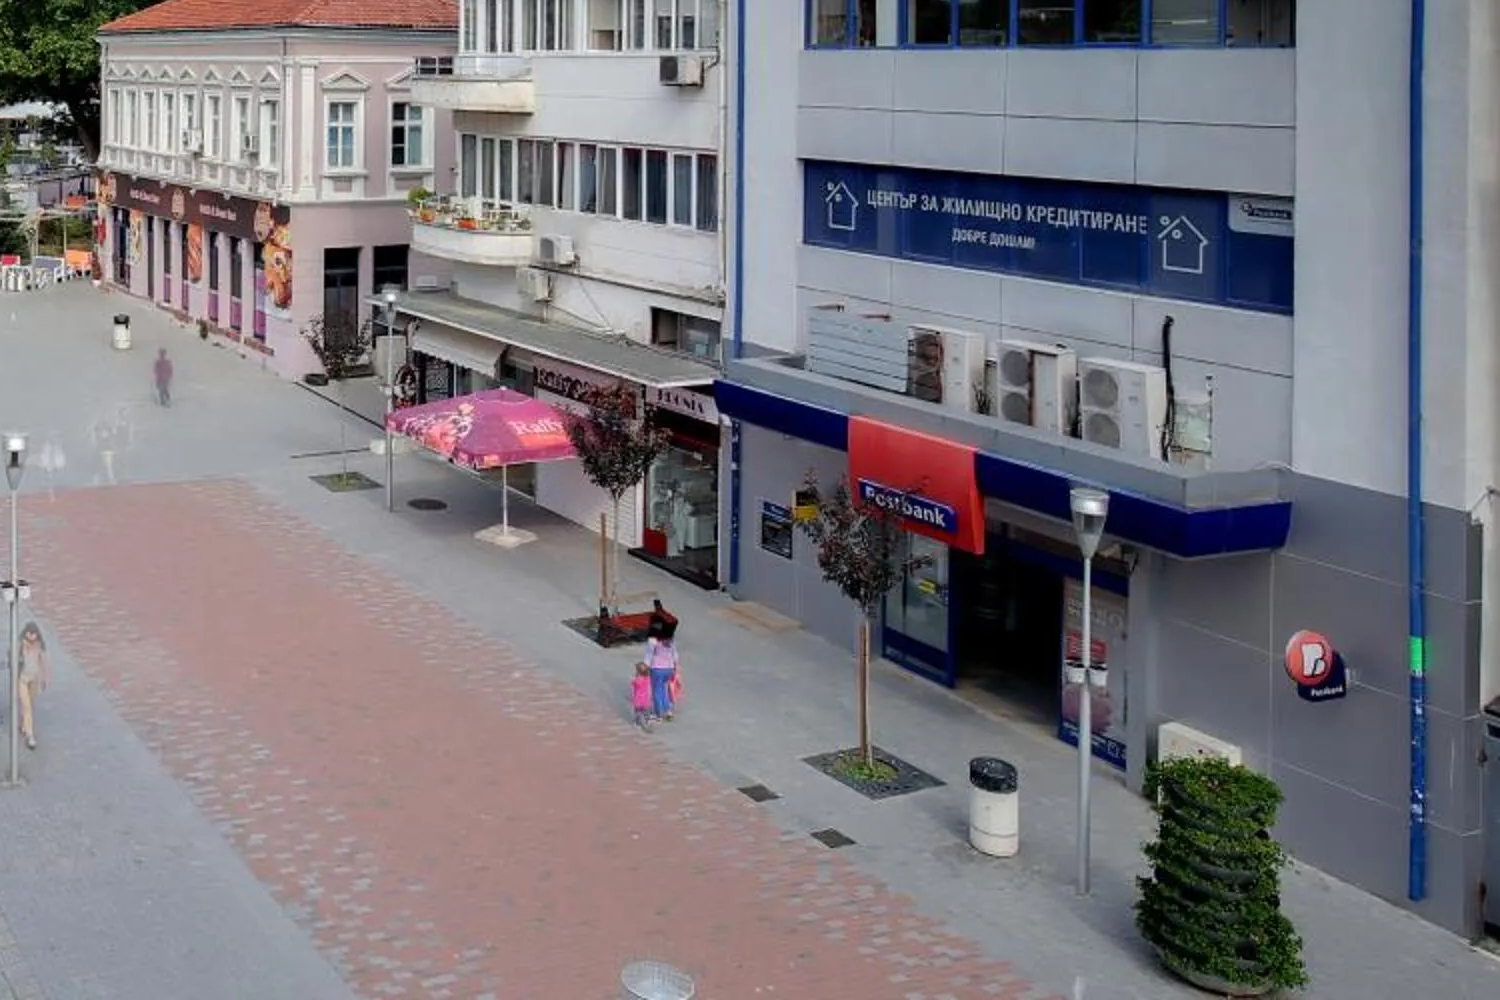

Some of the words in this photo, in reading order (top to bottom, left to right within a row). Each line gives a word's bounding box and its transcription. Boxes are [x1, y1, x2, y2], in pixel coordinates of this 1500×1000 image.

[867, 189, 917, 209] ЦЕНТЪР
[920, 195, 938, 212] ЗА
[941, 197, 1022, 222] ЖИЛИЩНО
[1026, 204, 1149, 235] КРЕДИТИРАНЕ
